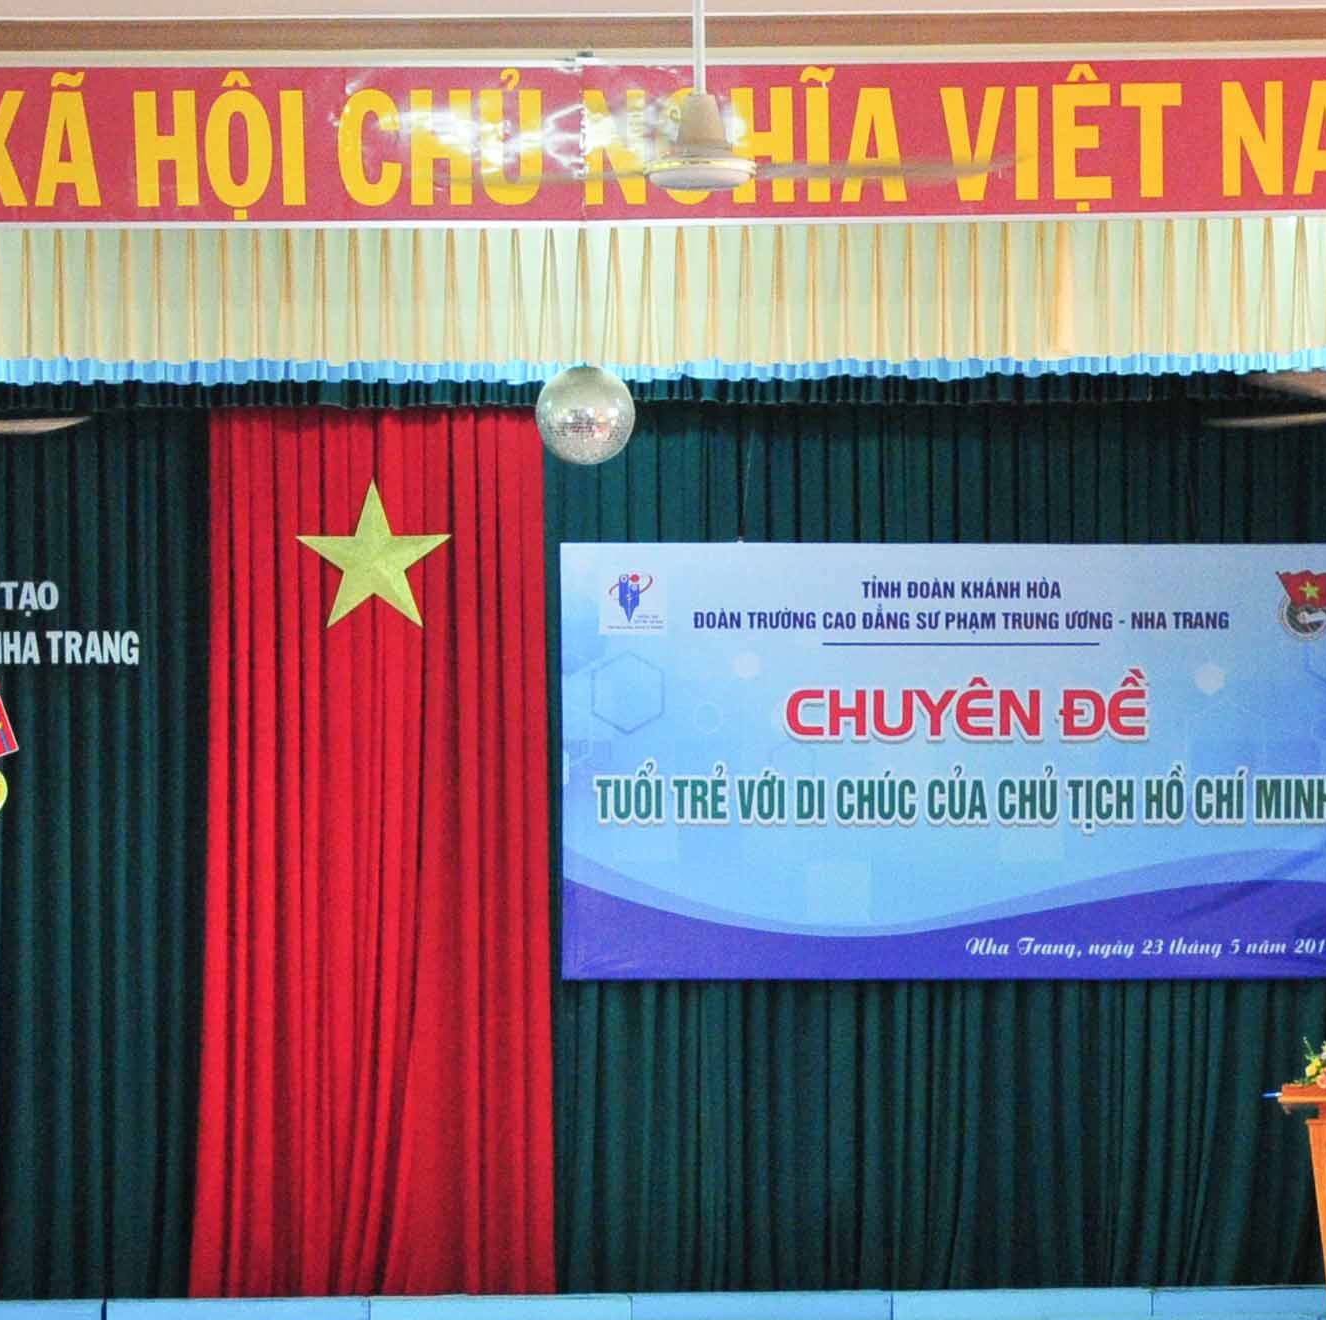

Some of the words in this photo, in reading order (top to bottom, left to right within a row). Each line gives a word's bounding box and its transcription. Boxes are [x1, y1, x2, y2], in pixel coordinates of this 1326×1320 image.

[137, 70, 305, 220] HỘI
[337, 67, 543, 207] CHỦ
[939, 63, 1183, 212] VIỆT
[862, 575, 902, 600] TỈNH
[907, 576, 956, 600] ĐOÀN
[961, 576, 1022, 600] KHÁNH
[1026, 576, 1062, 600] HÒA
[693, 607, 742, 630] ĐOÀN
[747, 607, 817, 630] TRƯỜNG
[822, 610, 857, 631] CAO
[862, 603, 911, 631] ĐẲNG
[915, 609, 942, 631] SƯ
[945, 610, 997, 635] PHẠM
[1001, 610, 1060, 631] TRUNG
[1065, 609, 1114, 631] ƯƠNG
[1130, 610, 1168, 631] NHA
[1172, 610, 1230, 631] TRANG
[45, 630, 140, 666] TRANG
[784, 676, 1043, 739] CHUYÊN
[1059, 666, 1150, 739] ĐỀ
[595, 762, 663, 821] TUỔI
[674, 763, 728, 821] TRẺ
[737, 771, 786, 821] VỚI
[796, 778, 826, 821] DI
[836, 770, 917, 822] CHÚC
[926, 764, 989, 821] CỦA
[998, 765, 1058, 821] CHỦ
[1067, 778, 1134, 830] TỊCH
[1144, 764, 1185, 820] HỒ
[1195, 769, 1246, 820] CHÍ
[965, 936, 1010, 956] Nha
[1016, 936, 1083, 960] Trang,
[1088, 939, 1136, 959] ngày
[1141, 938, 1165, 956] 23
[1169, 937, 1223, 959] tháng
[1230, 939, 1239, 955] 5
[1246, 938, 1288, 956] năm
